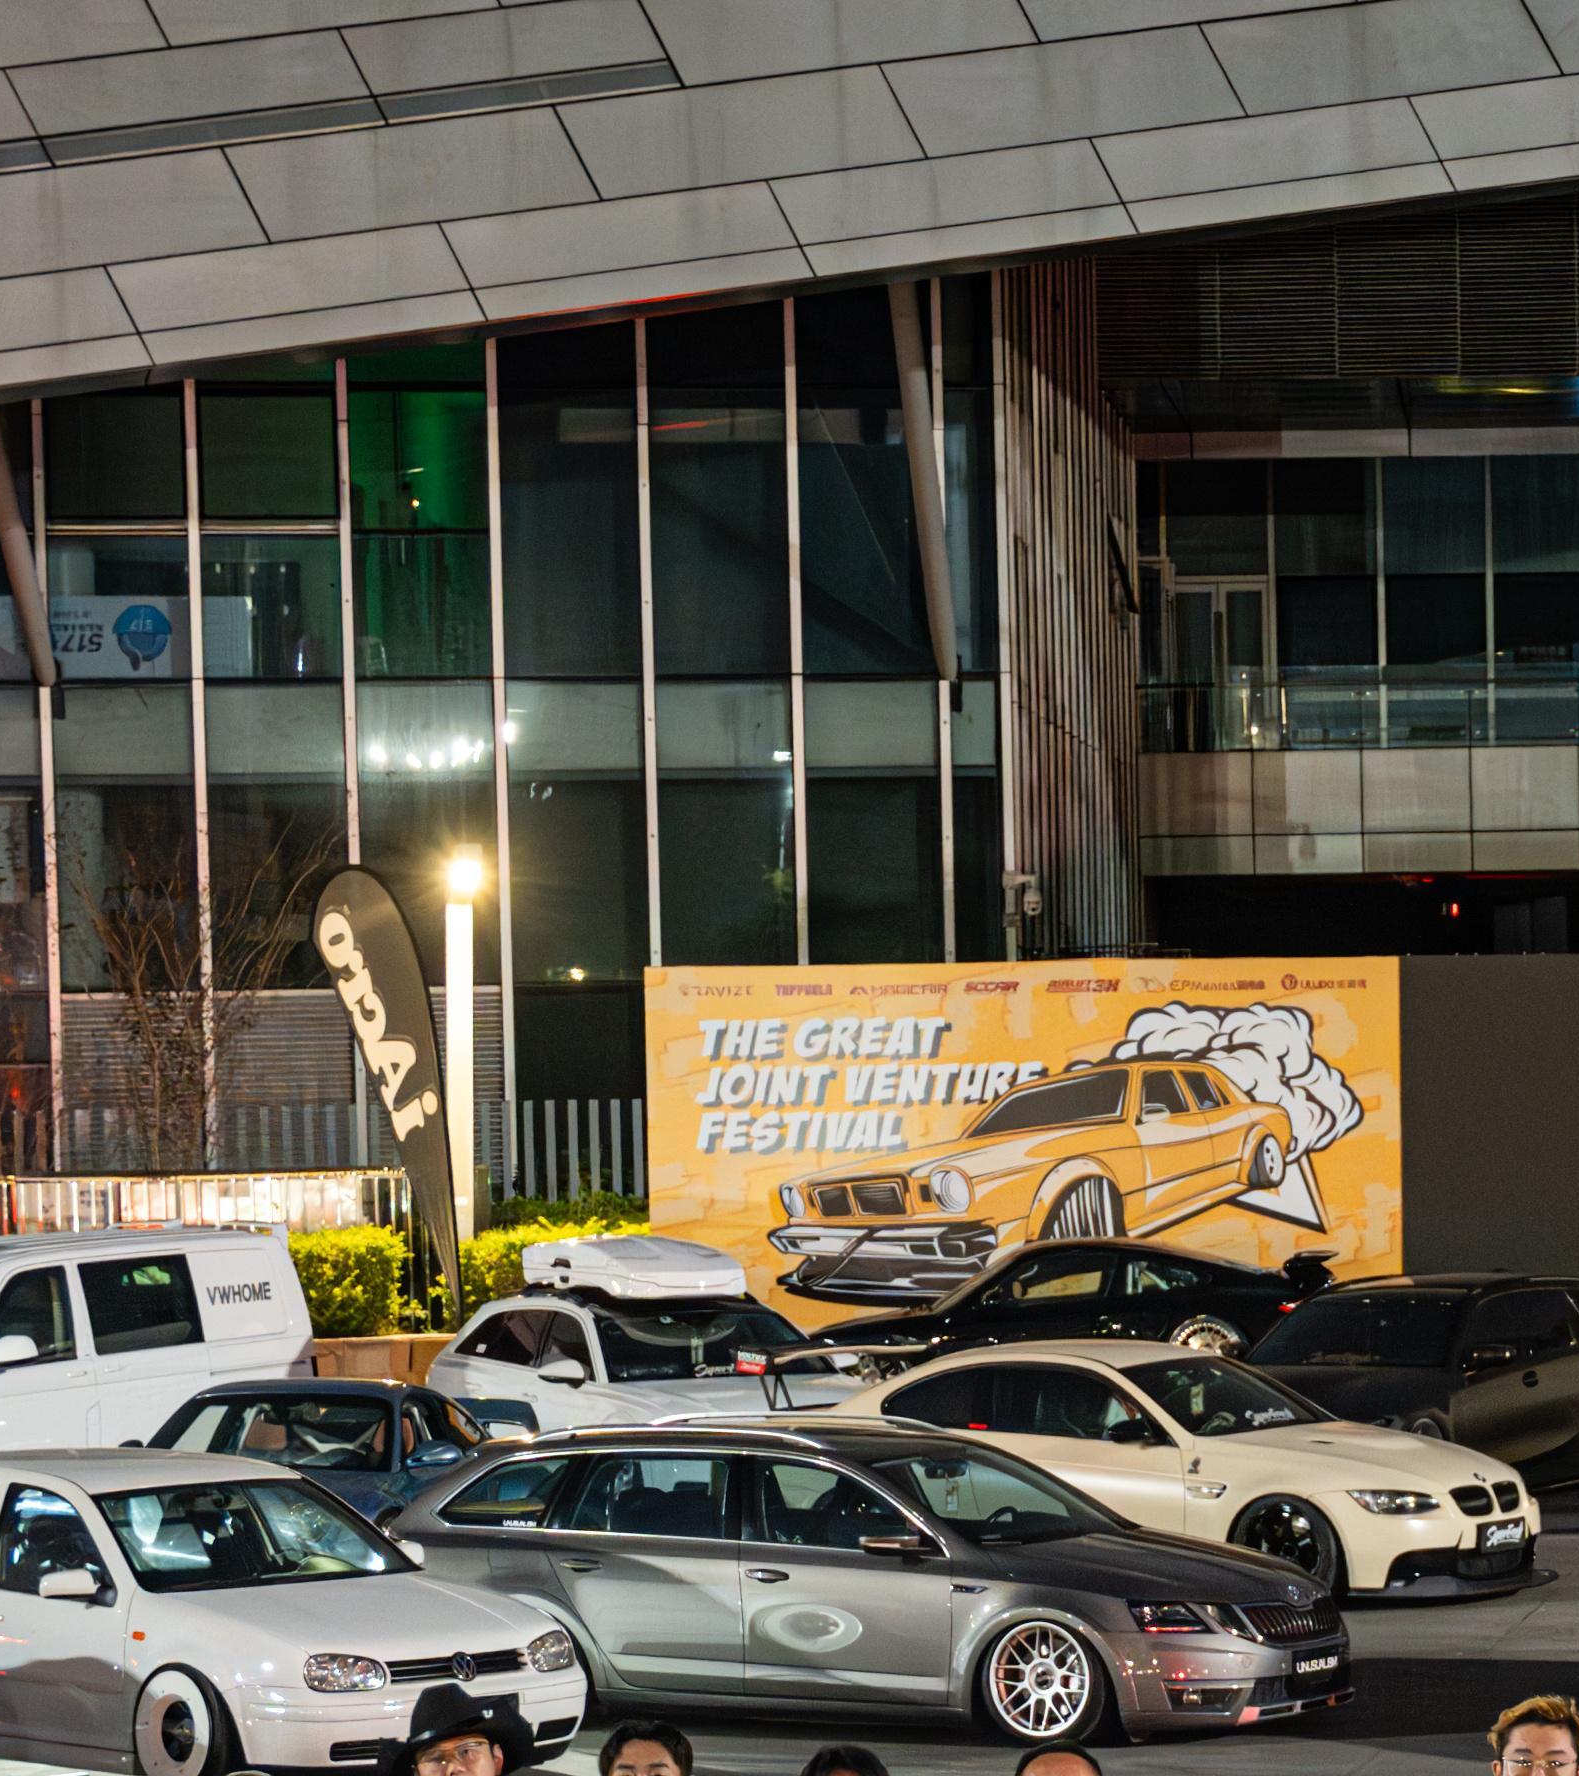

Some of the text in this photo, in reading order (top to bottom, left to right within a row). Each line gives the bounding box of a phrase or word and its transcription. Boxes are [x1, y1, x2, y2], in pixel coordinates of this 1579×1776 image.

[698, 1017, 947, 1059] THE GREAT
[696, 1061, 1046, 1106] JOINT VENTURE
[696, 1111, 903, 1152] FESTIVAL
[206, 1281, 272, 1306] VWHOME
